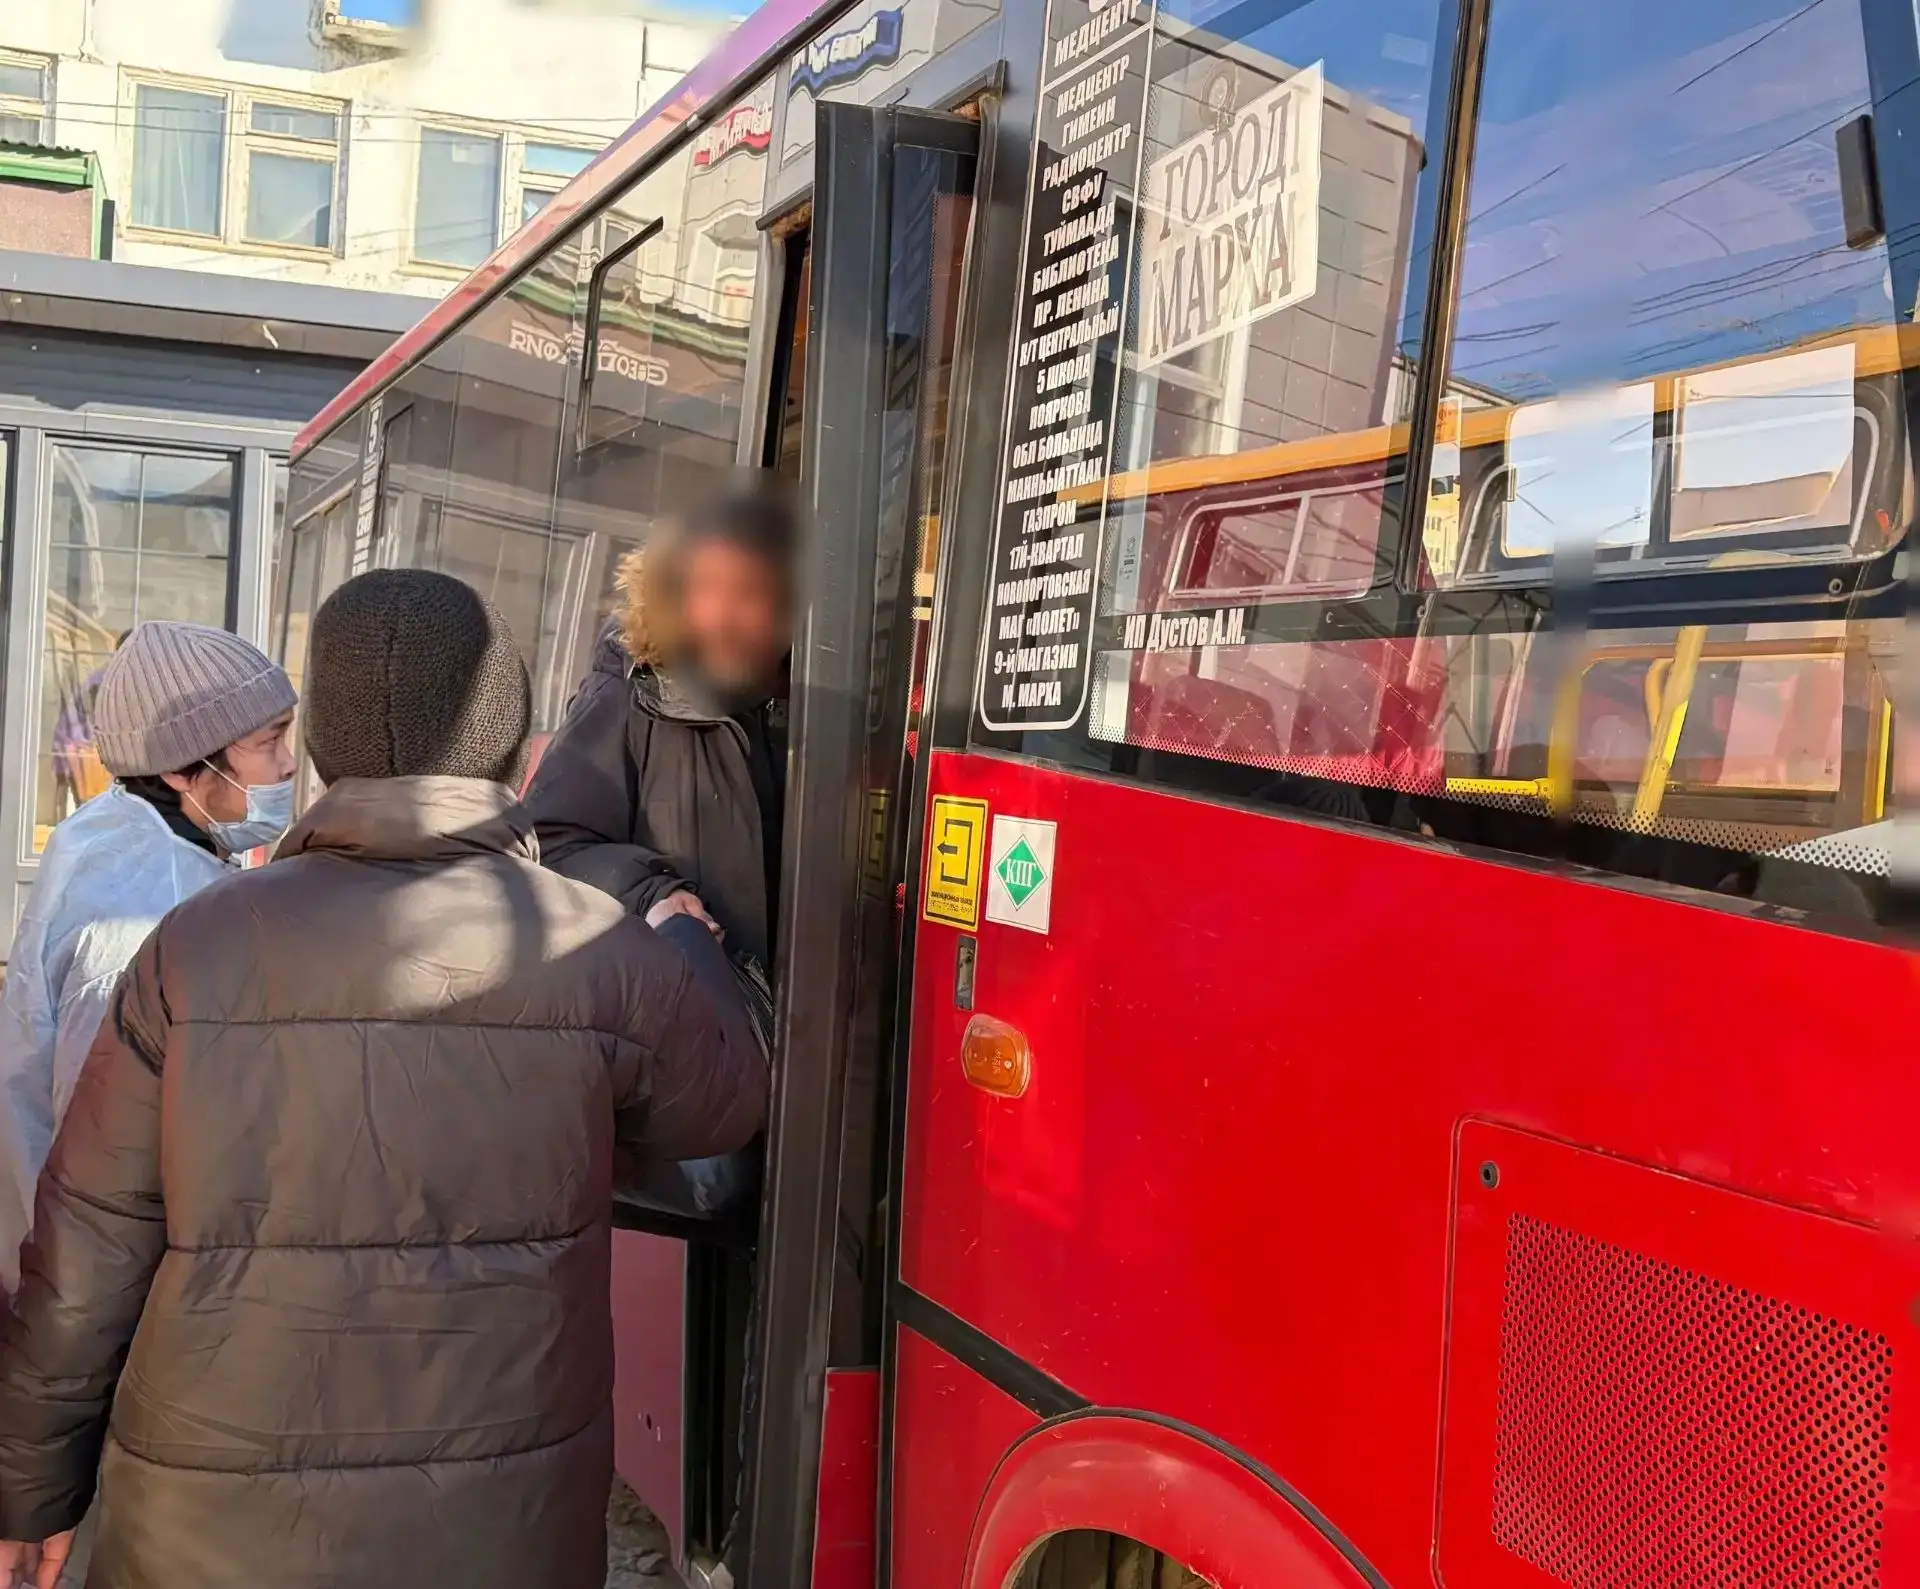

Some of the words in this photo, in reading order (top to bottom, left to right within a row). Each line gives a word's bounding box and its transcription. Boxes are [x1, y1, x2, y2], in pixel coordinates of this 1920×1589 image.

[1054, 0, 1142, 67] МЕДЦЕНТР
[1056, 54, 1130, 118] МЕДЦЕНТР
[1042, 123, 1132, 191] РАДИОЦЕНТР
[1160, 93, 1292, 241] ГОРОД
[1062, 172, 1103, 214] СВФУ
[1043, 201, 1116, 257] ТУЙМААДА
[1032, 234, 1119, 296] БИБЛИОТЕКА
[1150, 192, 1292, 358] МАРХА
[1033, 299, 1054, 328] ПР.
[1055, 274, 1110, 319] ЛЕНИНА
[1019, 338, 1039, 367] К/Т
[1038, 302, 1120, 362] ЦЕНТРАЛЬНЫЙ
[1036, 369, 1046, 394] 5
[1046, 352, 1091, 391] ШКОЛА
[1029, 388, 1092, 430] ПОЯРКОВА
[1012, 440, 1037, 469] ОБЛ
[1037, 420, 1103, 463] БОЛЬНИЦА
[1006, 456, 1103, 504] МАННЬЫАТТААХ
[1022, 499, 1077, 534] ГАЗПРОМ
[996, 568, 1092, 606] НОВОПОРТОВСКАЯ
[999, 613, 1025, 640] МАГ
[1123, 615, 1147, 649] ИП
[1146, 613, 1209, 653] Дустов
[1210, 608, 1246, 645] А.М.
[1017, 643, 1079, 672] МАГАЗИН
[1002, 684, 1016, 708] М.
[1018, 681, 1062, 707] МАРХА
[1005, 858, 1037, 888] КПГ
